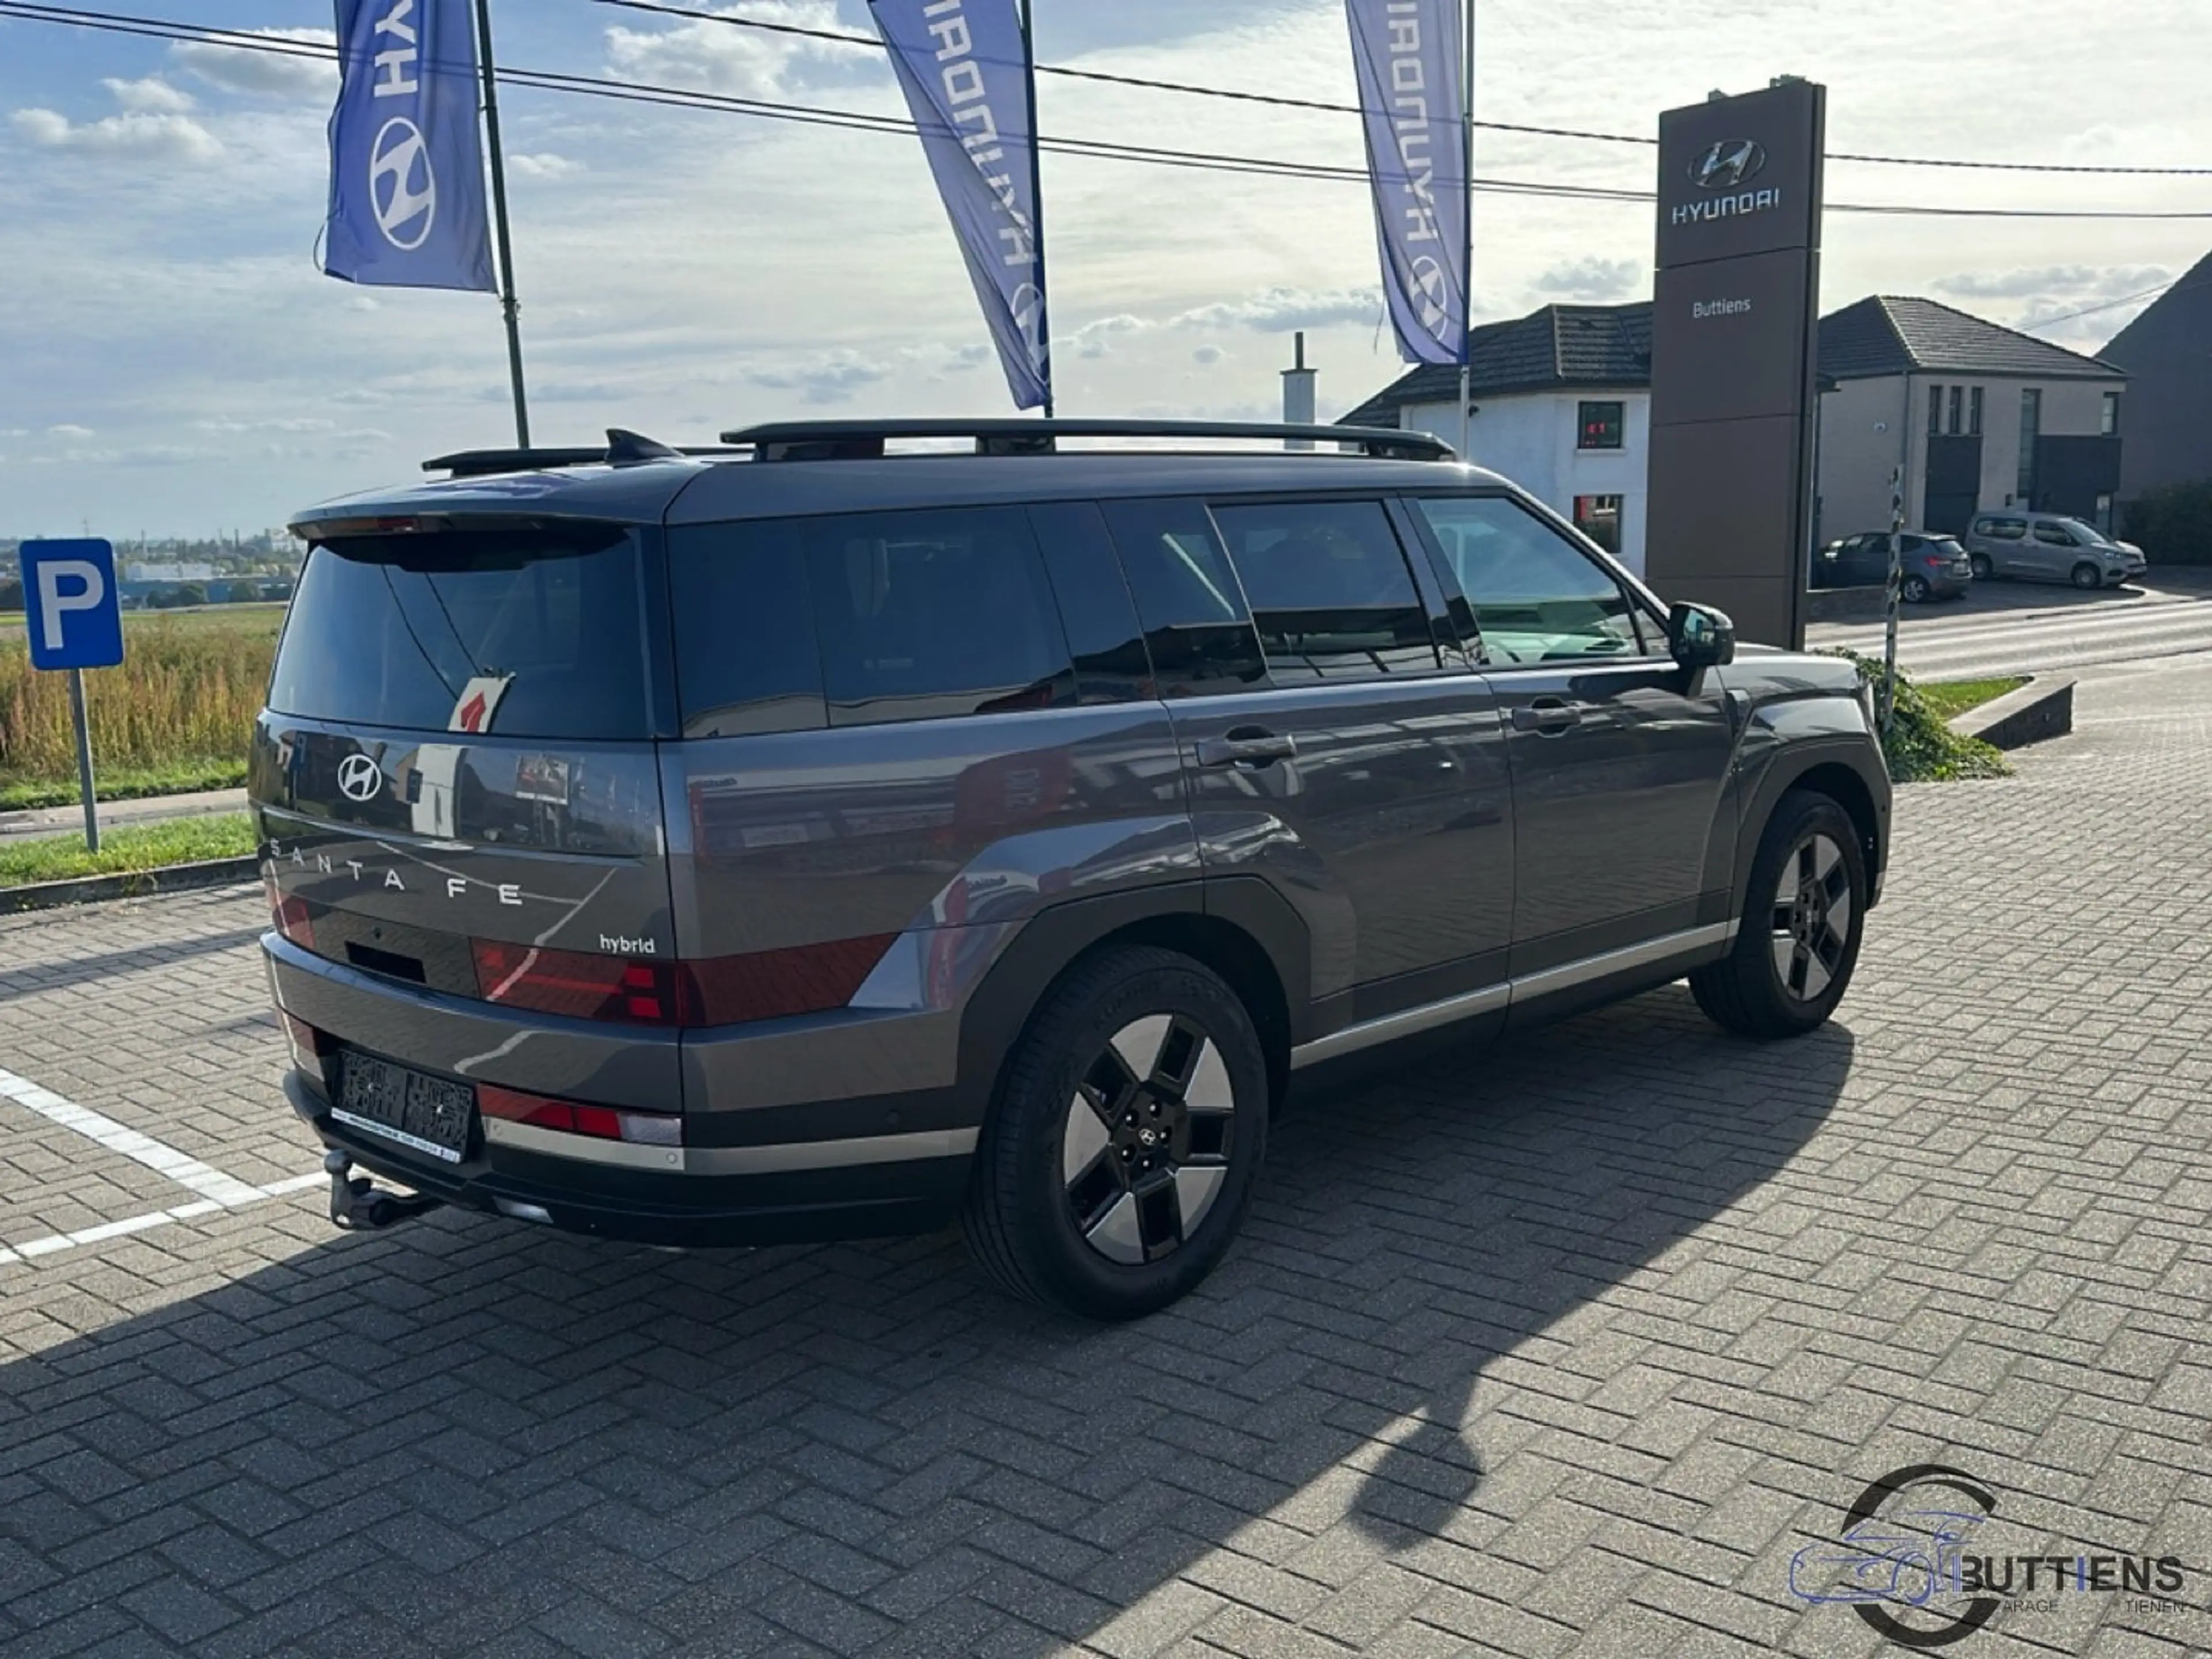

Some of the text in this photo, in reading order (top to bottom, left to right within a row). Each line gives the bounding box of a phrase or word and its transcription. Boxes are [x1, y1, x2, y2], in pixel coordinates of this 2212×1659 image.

[1672, 188, 1780, 225] HYUNDAI
[1694, 298, 1751, 318] Buttiens
[36, 560, 104, 650] P
[448, 878, 523, 905] FE
[600, 933, 656, 954] hybrid
